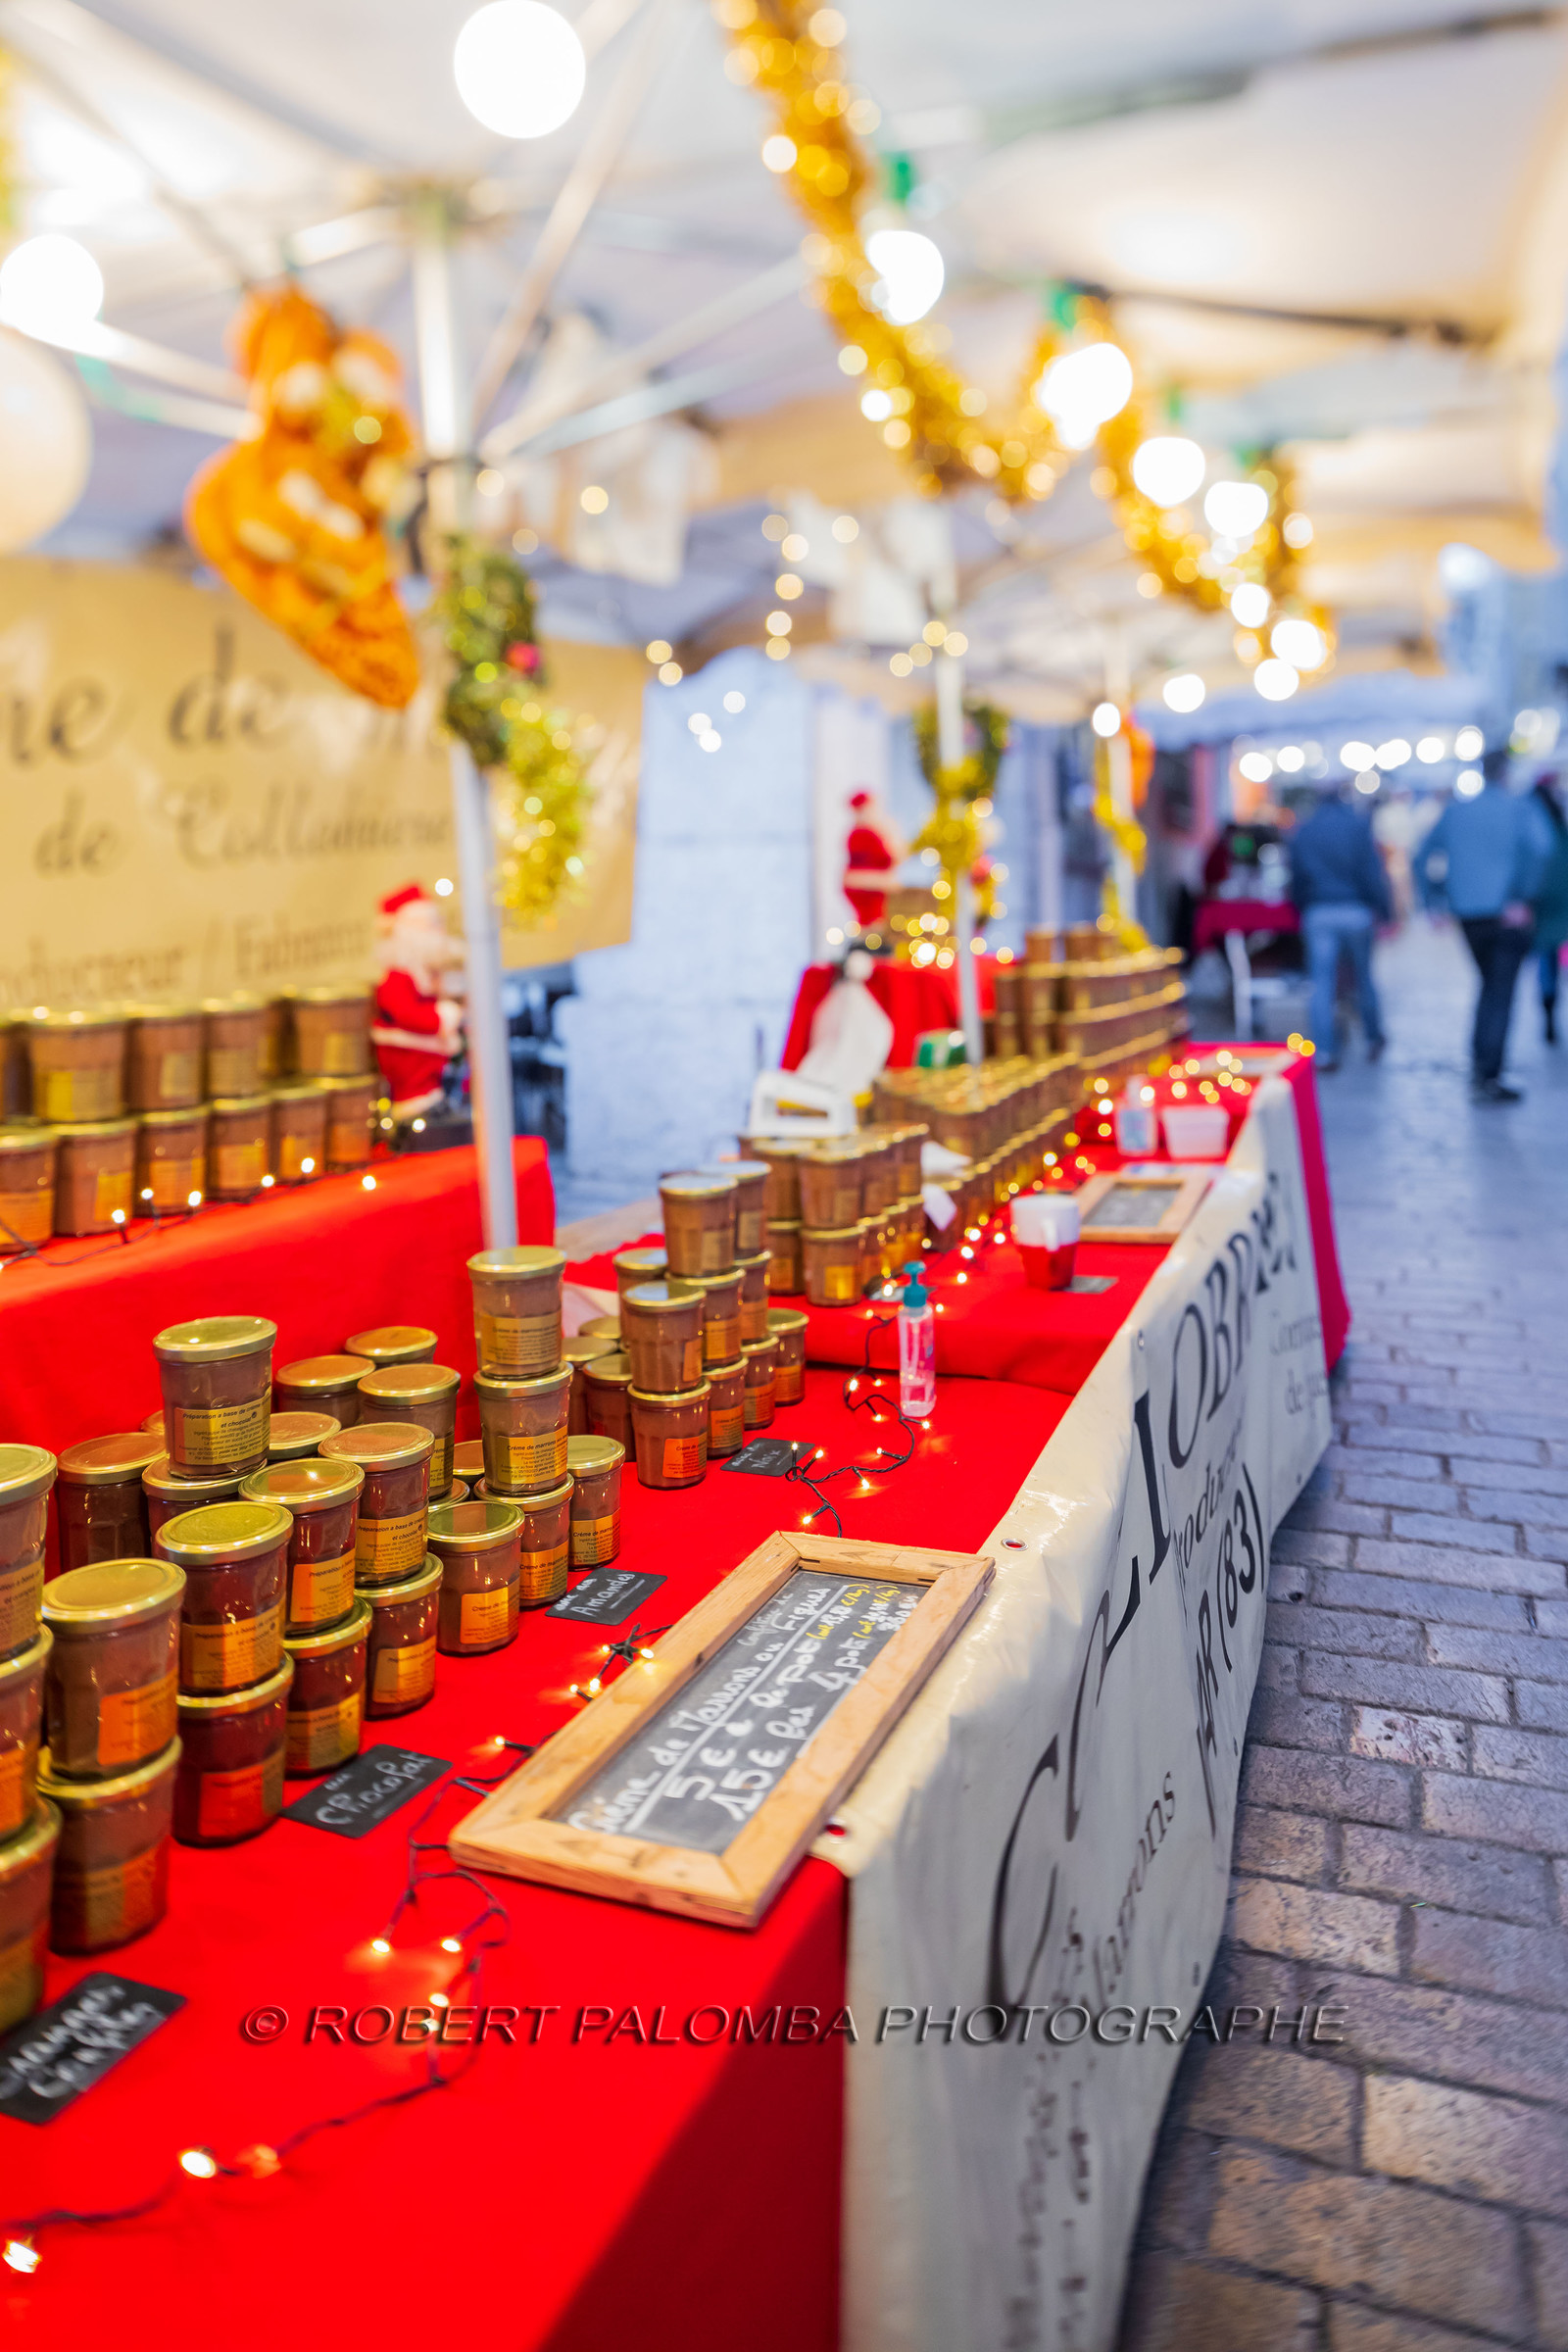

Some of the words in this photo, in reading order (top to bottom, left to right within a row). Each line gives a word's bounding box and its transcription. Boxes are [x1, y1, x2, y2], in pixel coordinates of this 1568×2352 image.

[166, 618, 294, 753] de
[31, 784, 128, 880] de
[569, 1573, 635, 1618] Amandes
[1216, 1460, 1265, 1674] (83)
[770, 1588, 832, 1631] Figues
[775, 1639, 822, 1687] pot
[667, 1666, 762, 1732] Marrons
[648, 1739, 690, 1766] de
[316, 1752, 433, 1824] Chocolat
